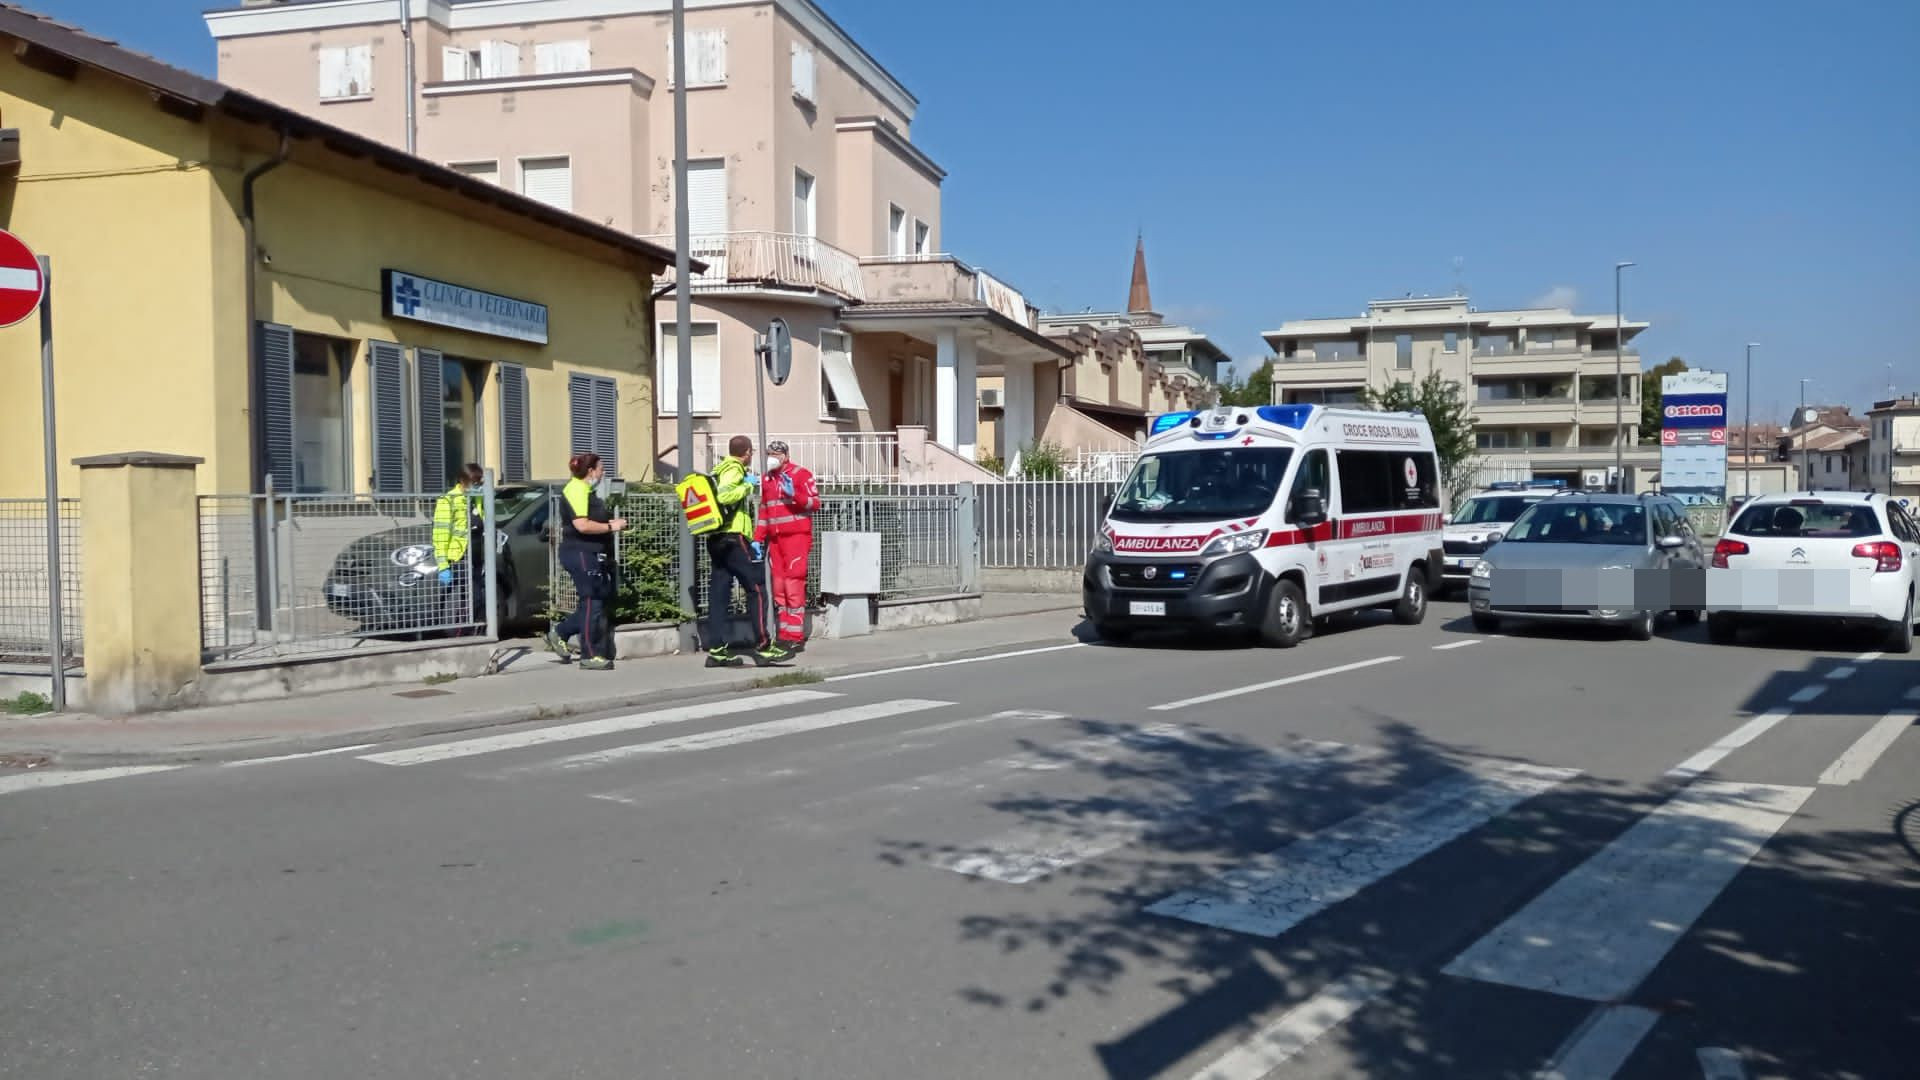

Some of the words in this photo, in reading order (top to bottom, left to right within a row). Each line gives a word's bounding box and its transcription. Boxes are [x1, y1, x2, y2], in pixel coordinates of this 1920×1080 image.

[424, 282, 473, 308] CLINICA
[479, 295, 546, 323] VETERINARIA
[1343, 423, 1368, 437] CROCE
[1369, 425, 1391, 438] ROSSA
[1391, 426, 1419, 439] ITALIANA
[1352, 521, 1385, 535] AMBULANZA
[1115, 538, 1200, 549] AMBULANZA
